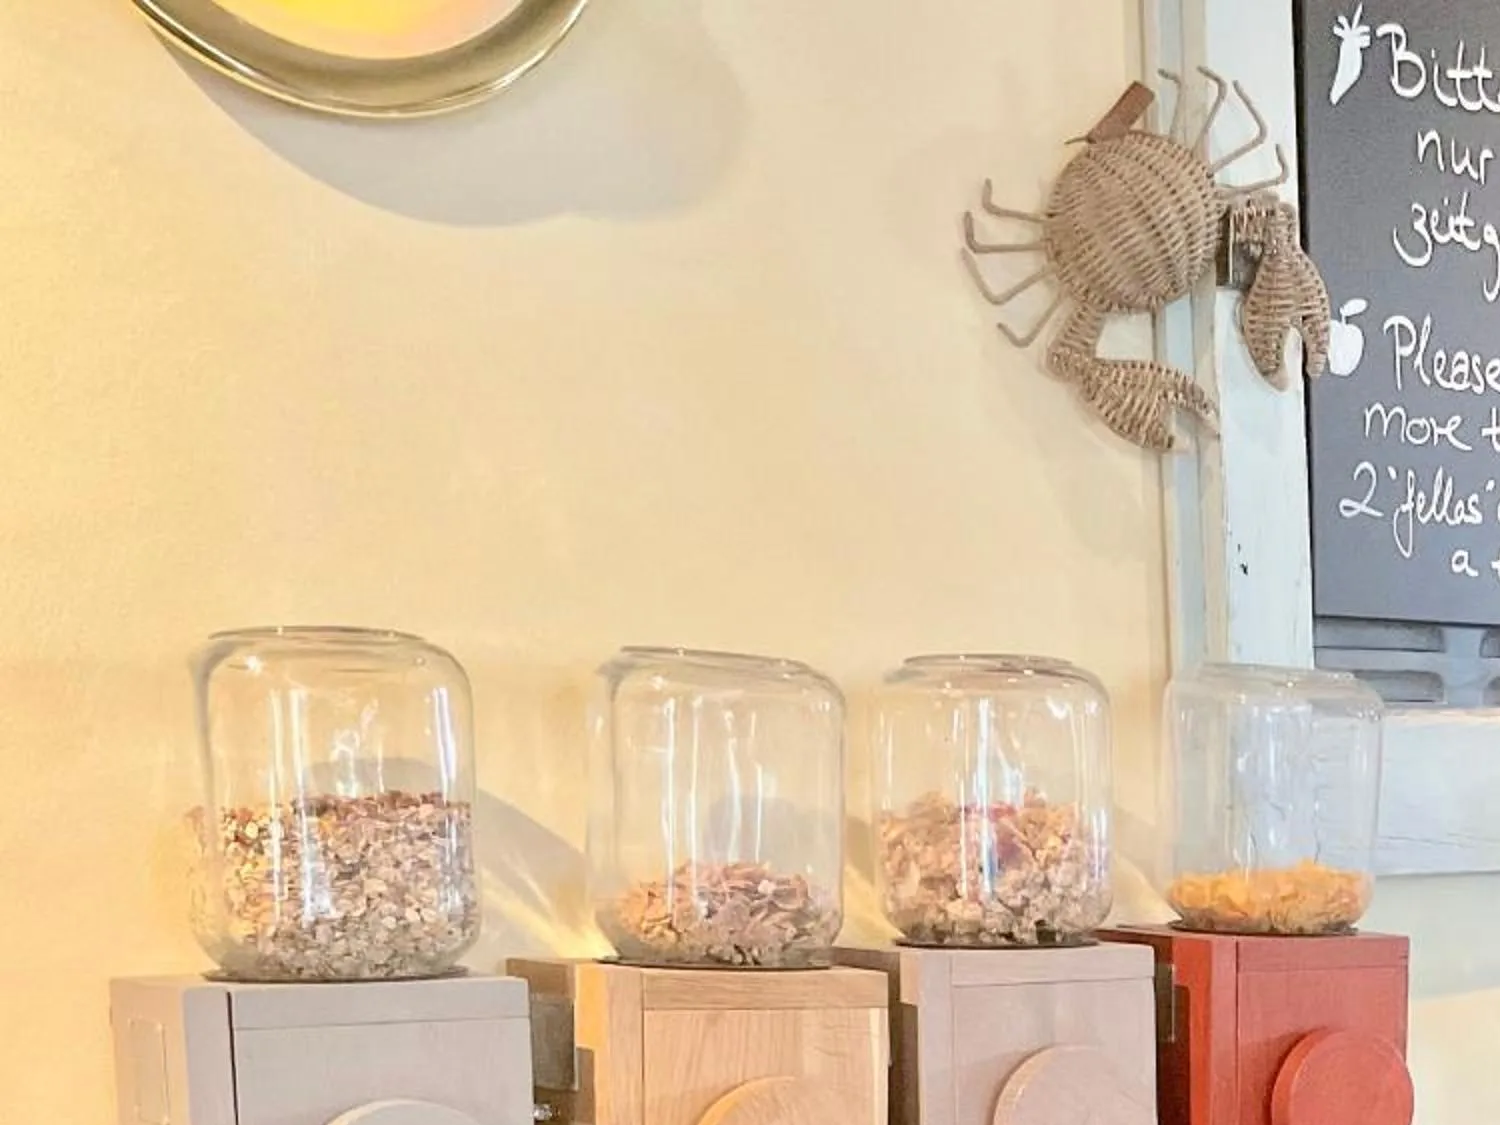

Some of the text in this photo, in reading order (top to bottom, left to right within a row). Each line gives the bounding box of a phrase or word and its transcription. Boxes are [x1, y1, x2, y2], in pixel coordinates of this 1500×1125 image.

[1417, 128, 1497, 185] nur
[1364, 402, 1473, 451] more
[1338, 460, 1385, 518] 2
[1451, 549, 1479, 578] a
